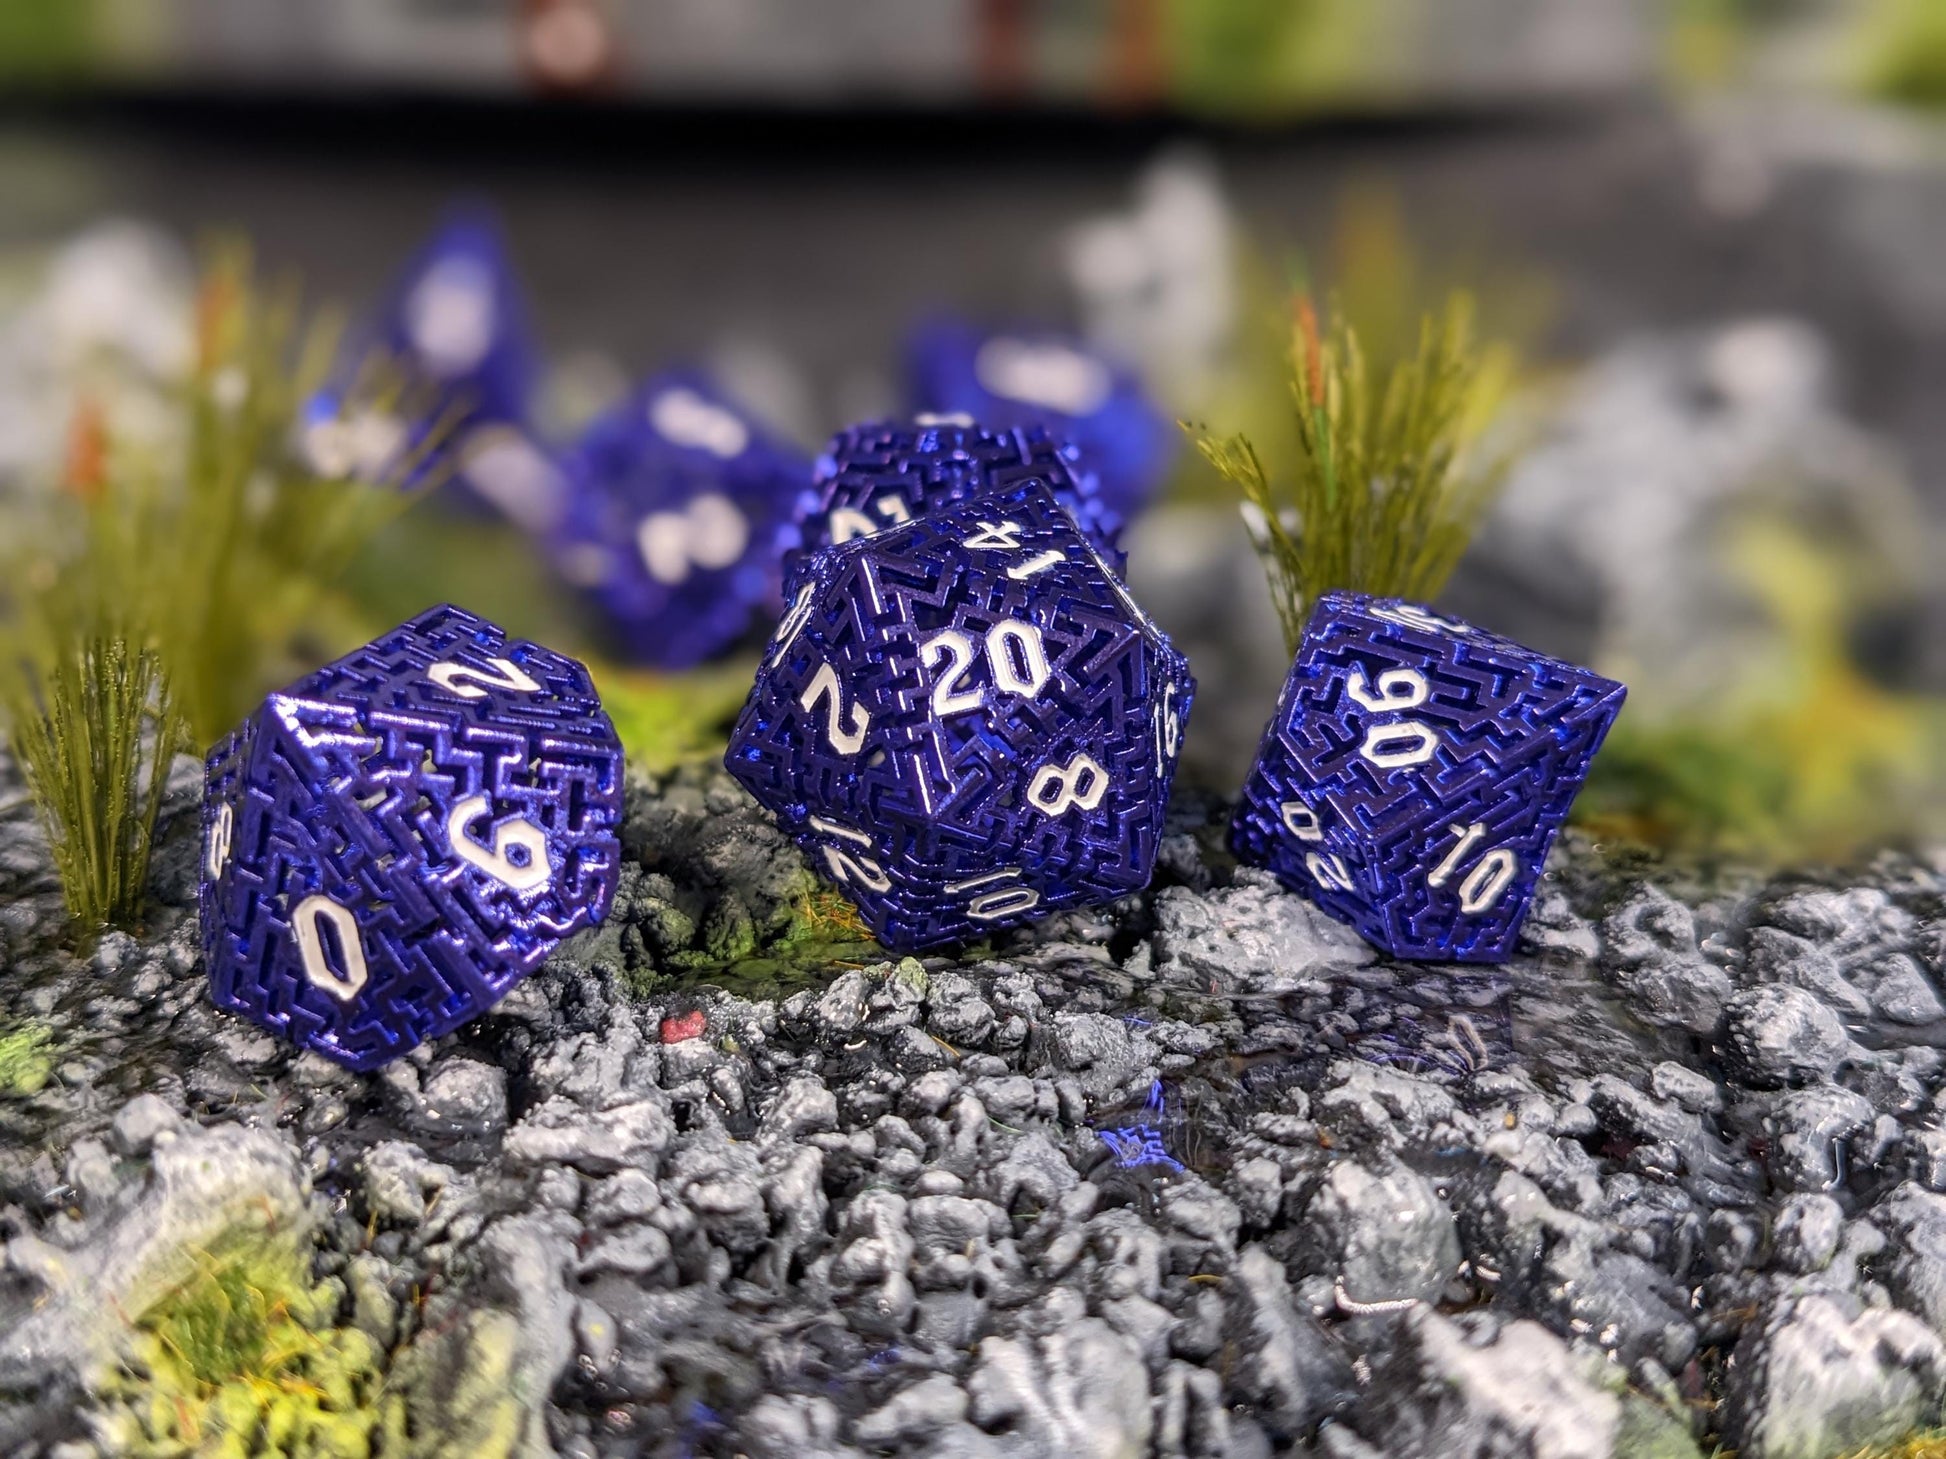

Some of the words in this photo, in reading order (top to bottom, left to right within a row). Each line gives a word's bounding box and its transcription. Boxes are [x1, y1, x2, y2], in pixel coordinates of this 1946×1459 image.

[771, 581, 816, 669] 18
[920, 619, 1049, 716] 20
[428, 658, 541, 697] 2
[801, 662, 870, 755] 2
[1154, 681, 1178, 779] 16
[1028, 752, 1109, 816] 8
[210, 801, 233, 880] 8
[448, 795, 552, 889] 6
[809, 815, 892, 893] 12
[1429, 822, 1517, 915] 10
[943, 867, 1039, 919] 10
[292, 894, 368, 1001] 0
